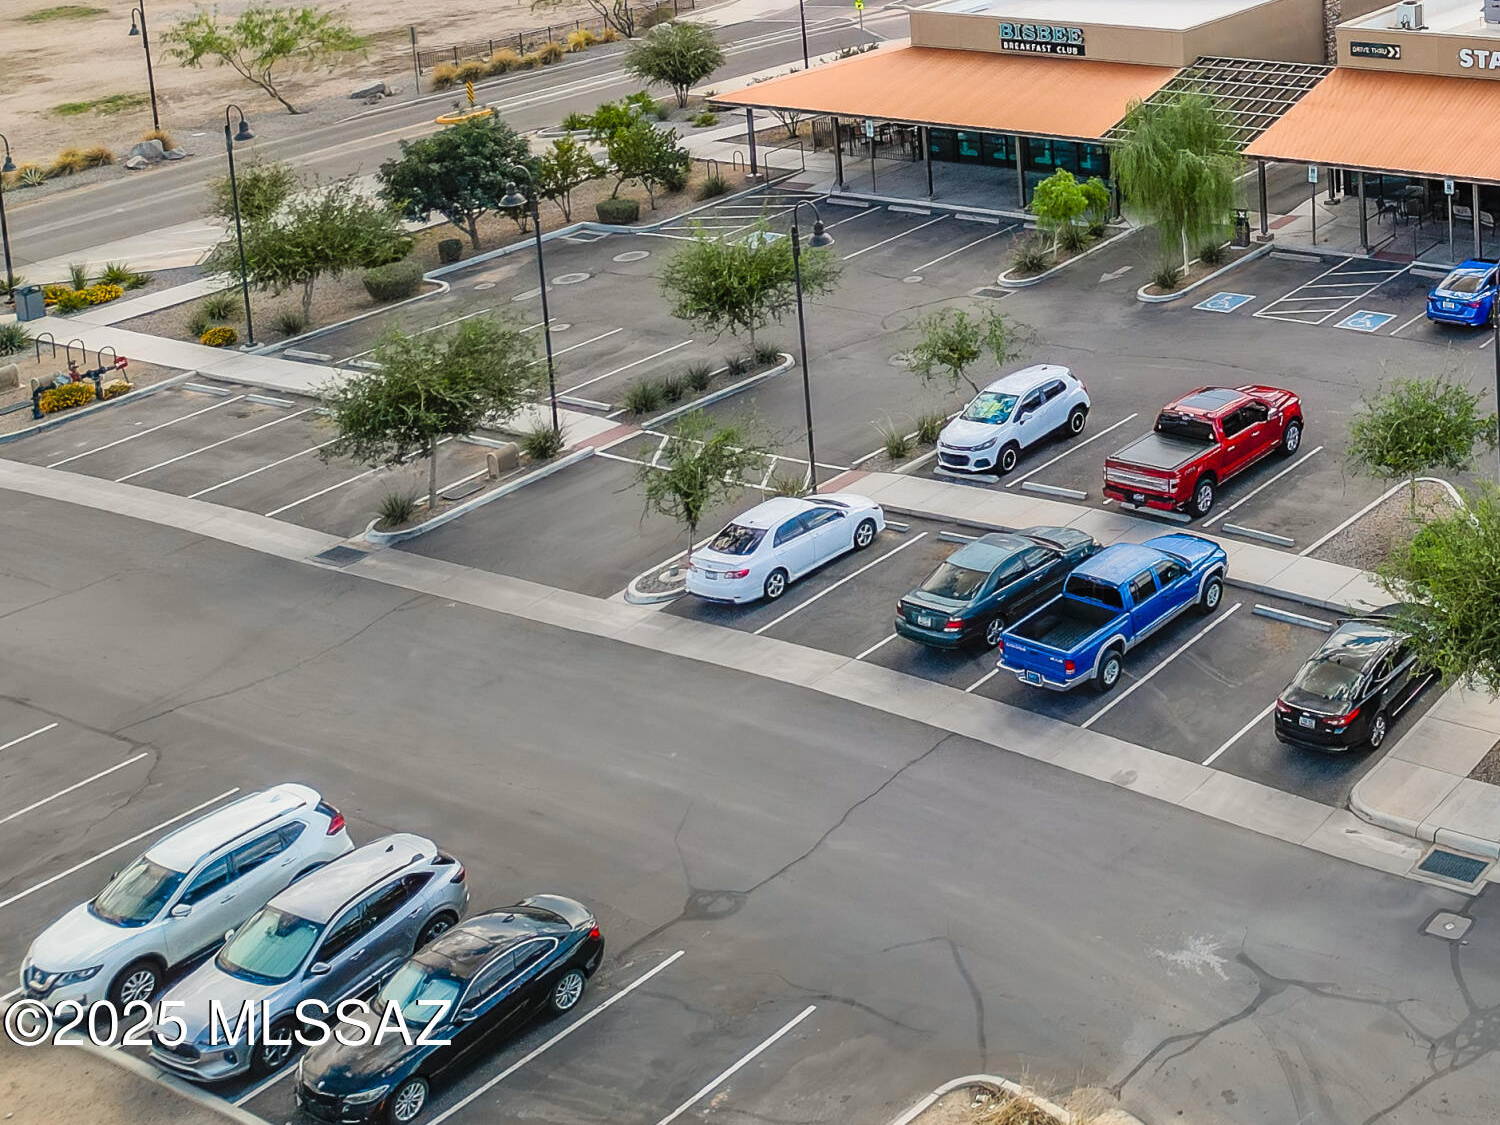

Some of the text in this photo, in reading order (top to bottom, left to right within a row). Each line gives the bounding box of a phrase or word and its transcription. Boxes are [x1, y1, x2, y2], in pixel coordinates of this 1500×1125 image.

[999, 23, 1084, 45] BISBEE
[1003, 41, 1079, 55] BREAKFAST CLUB
